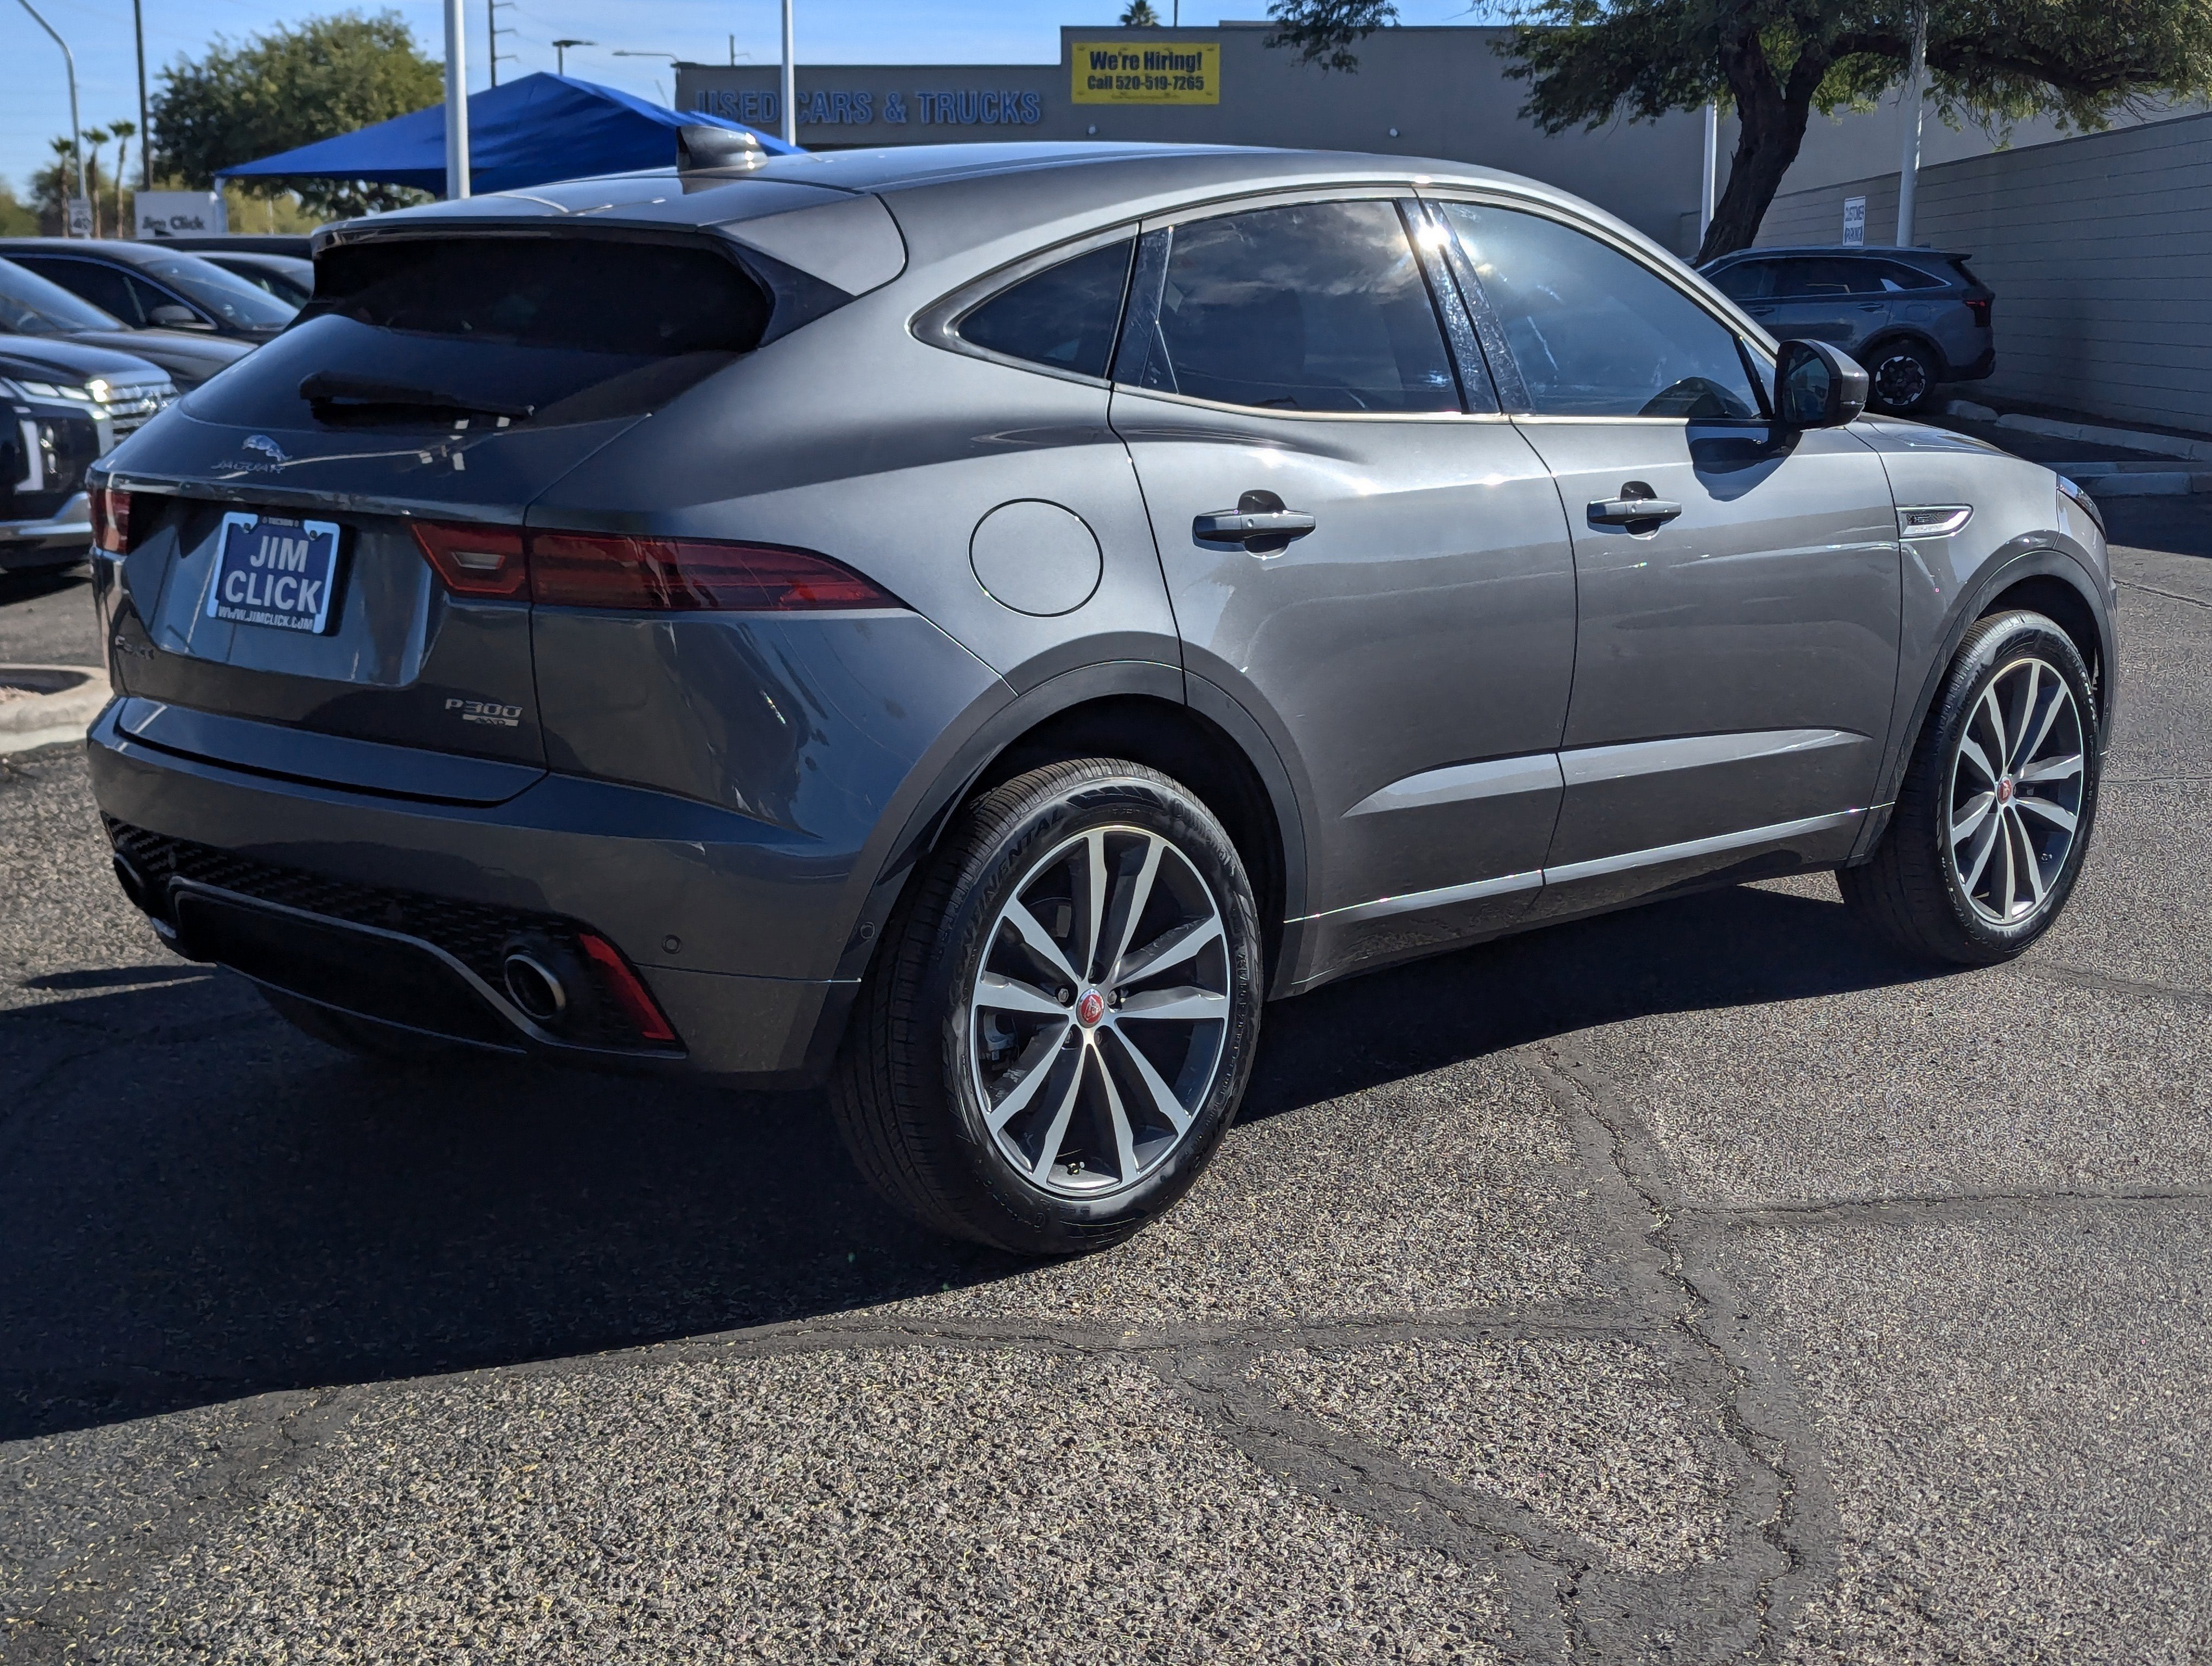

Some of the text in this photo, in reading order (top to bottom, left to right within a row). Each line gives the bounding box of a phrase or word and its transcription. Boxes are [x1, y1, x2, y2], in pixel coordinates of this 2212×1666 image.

[1090, 52, 1202, 73] We're Hiring!
[1087, 75, 1205, 91] Call 520-519-7265
[696, 90, 1040, 124] USED CARS & TRUCKS
[249, 535, 309, 573] JIM
[225, 569, 323, 614] CLICK
[445, 698, 523, 717] P300
